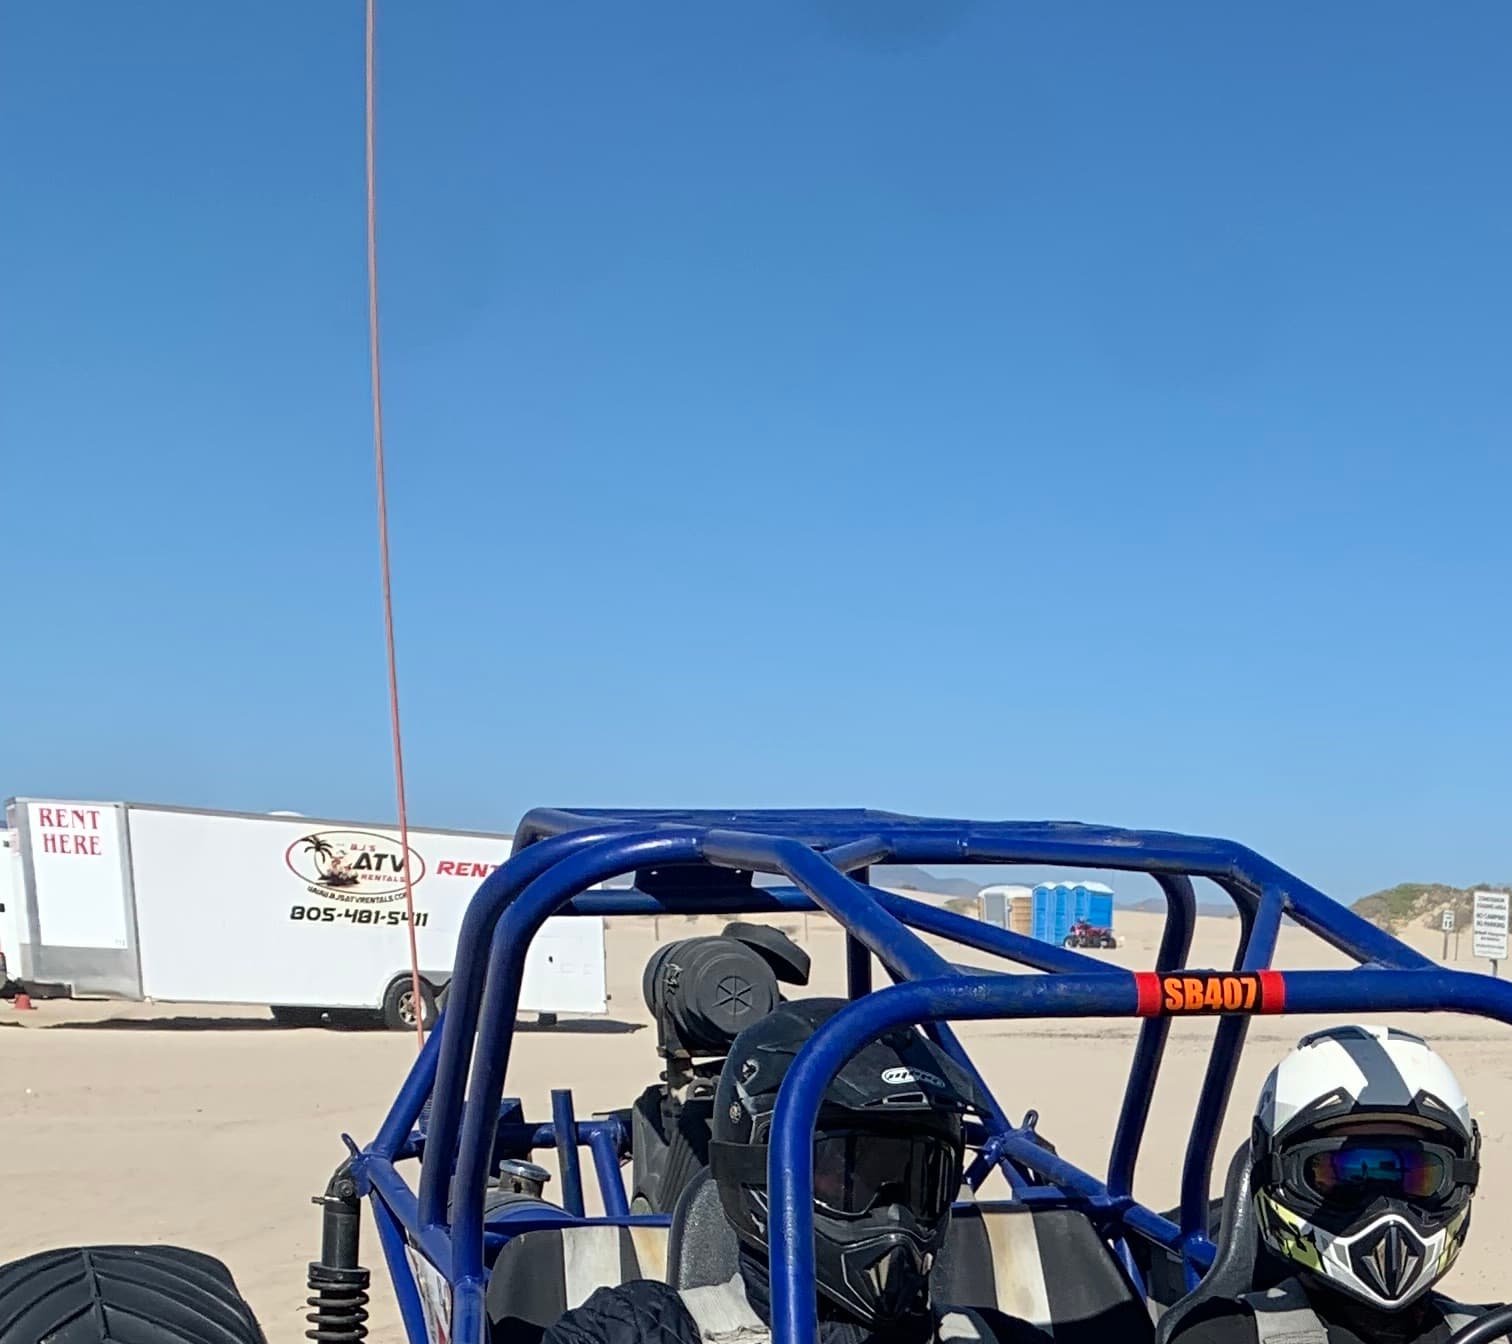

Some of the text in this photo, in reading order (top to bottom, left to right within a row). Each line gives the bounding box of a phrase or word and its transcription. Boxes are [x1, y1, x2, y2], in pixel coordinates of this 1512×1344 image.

[38, 807, 101, 830] RENT
[43, 833, 102, 856] HERE
[352, 852, 406, 873] ATV
[290, 905, 428, 927] 805-481-5411
[1163, 977, 1257, 1010] SB407
